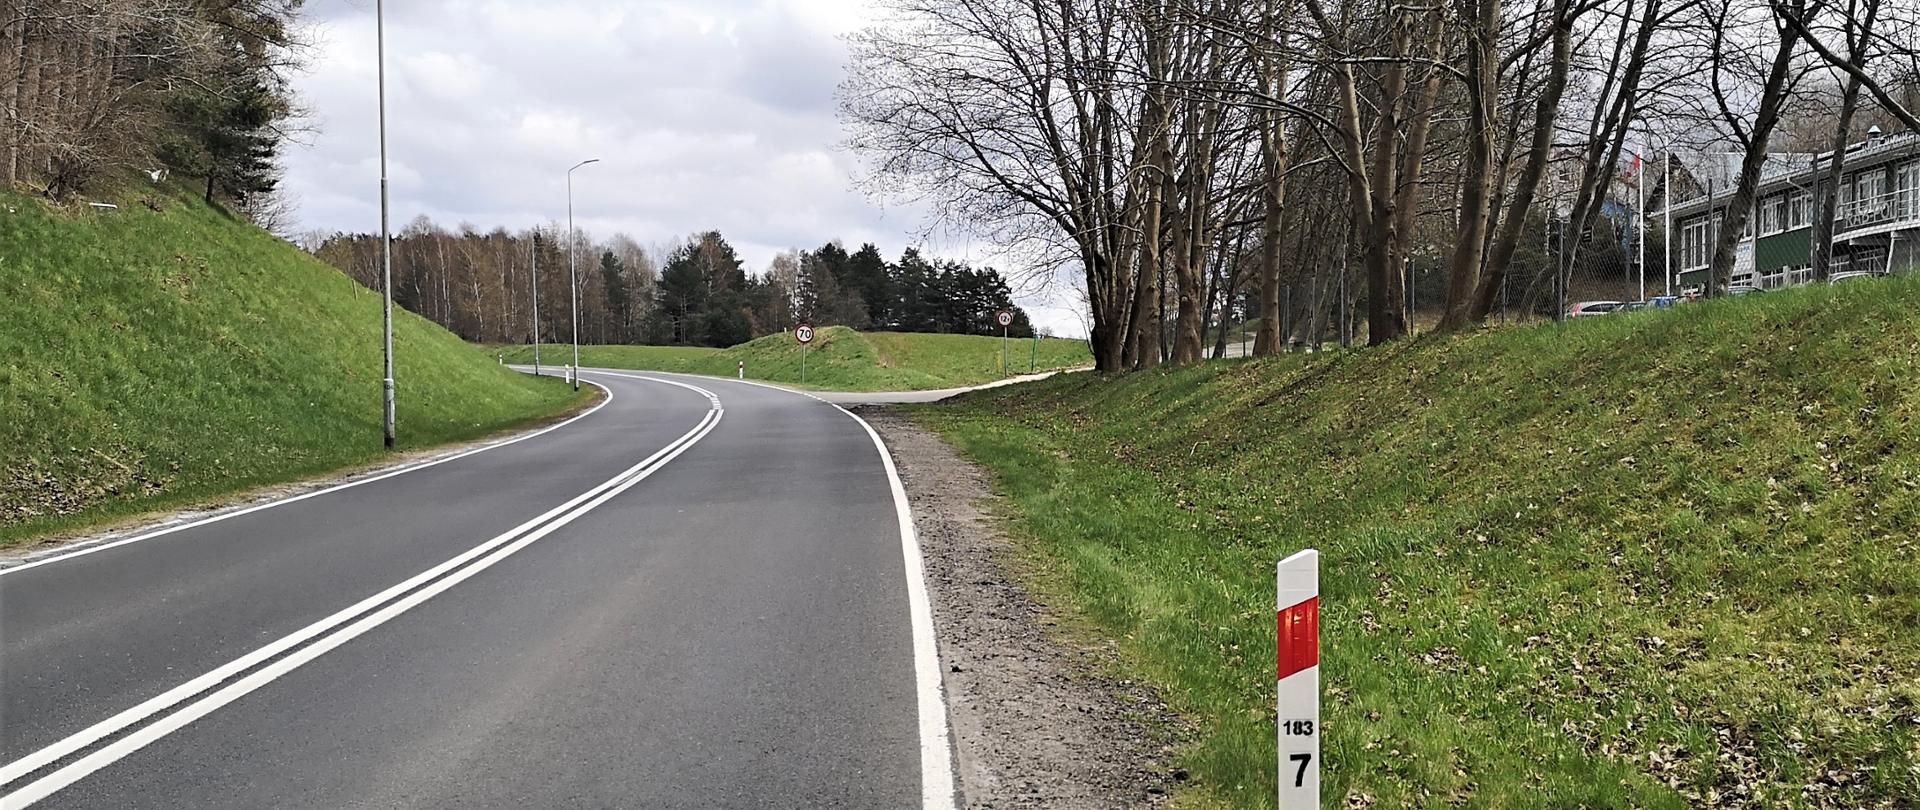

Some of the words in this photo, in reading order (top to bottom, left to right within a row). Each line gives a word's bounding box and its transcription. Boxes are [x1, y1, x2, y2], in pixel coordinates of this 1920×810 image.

[800, 329, 811, 338] 70
[1283, 720, 1313, 736] 183
[1290, 753, 1311, 787] 7
